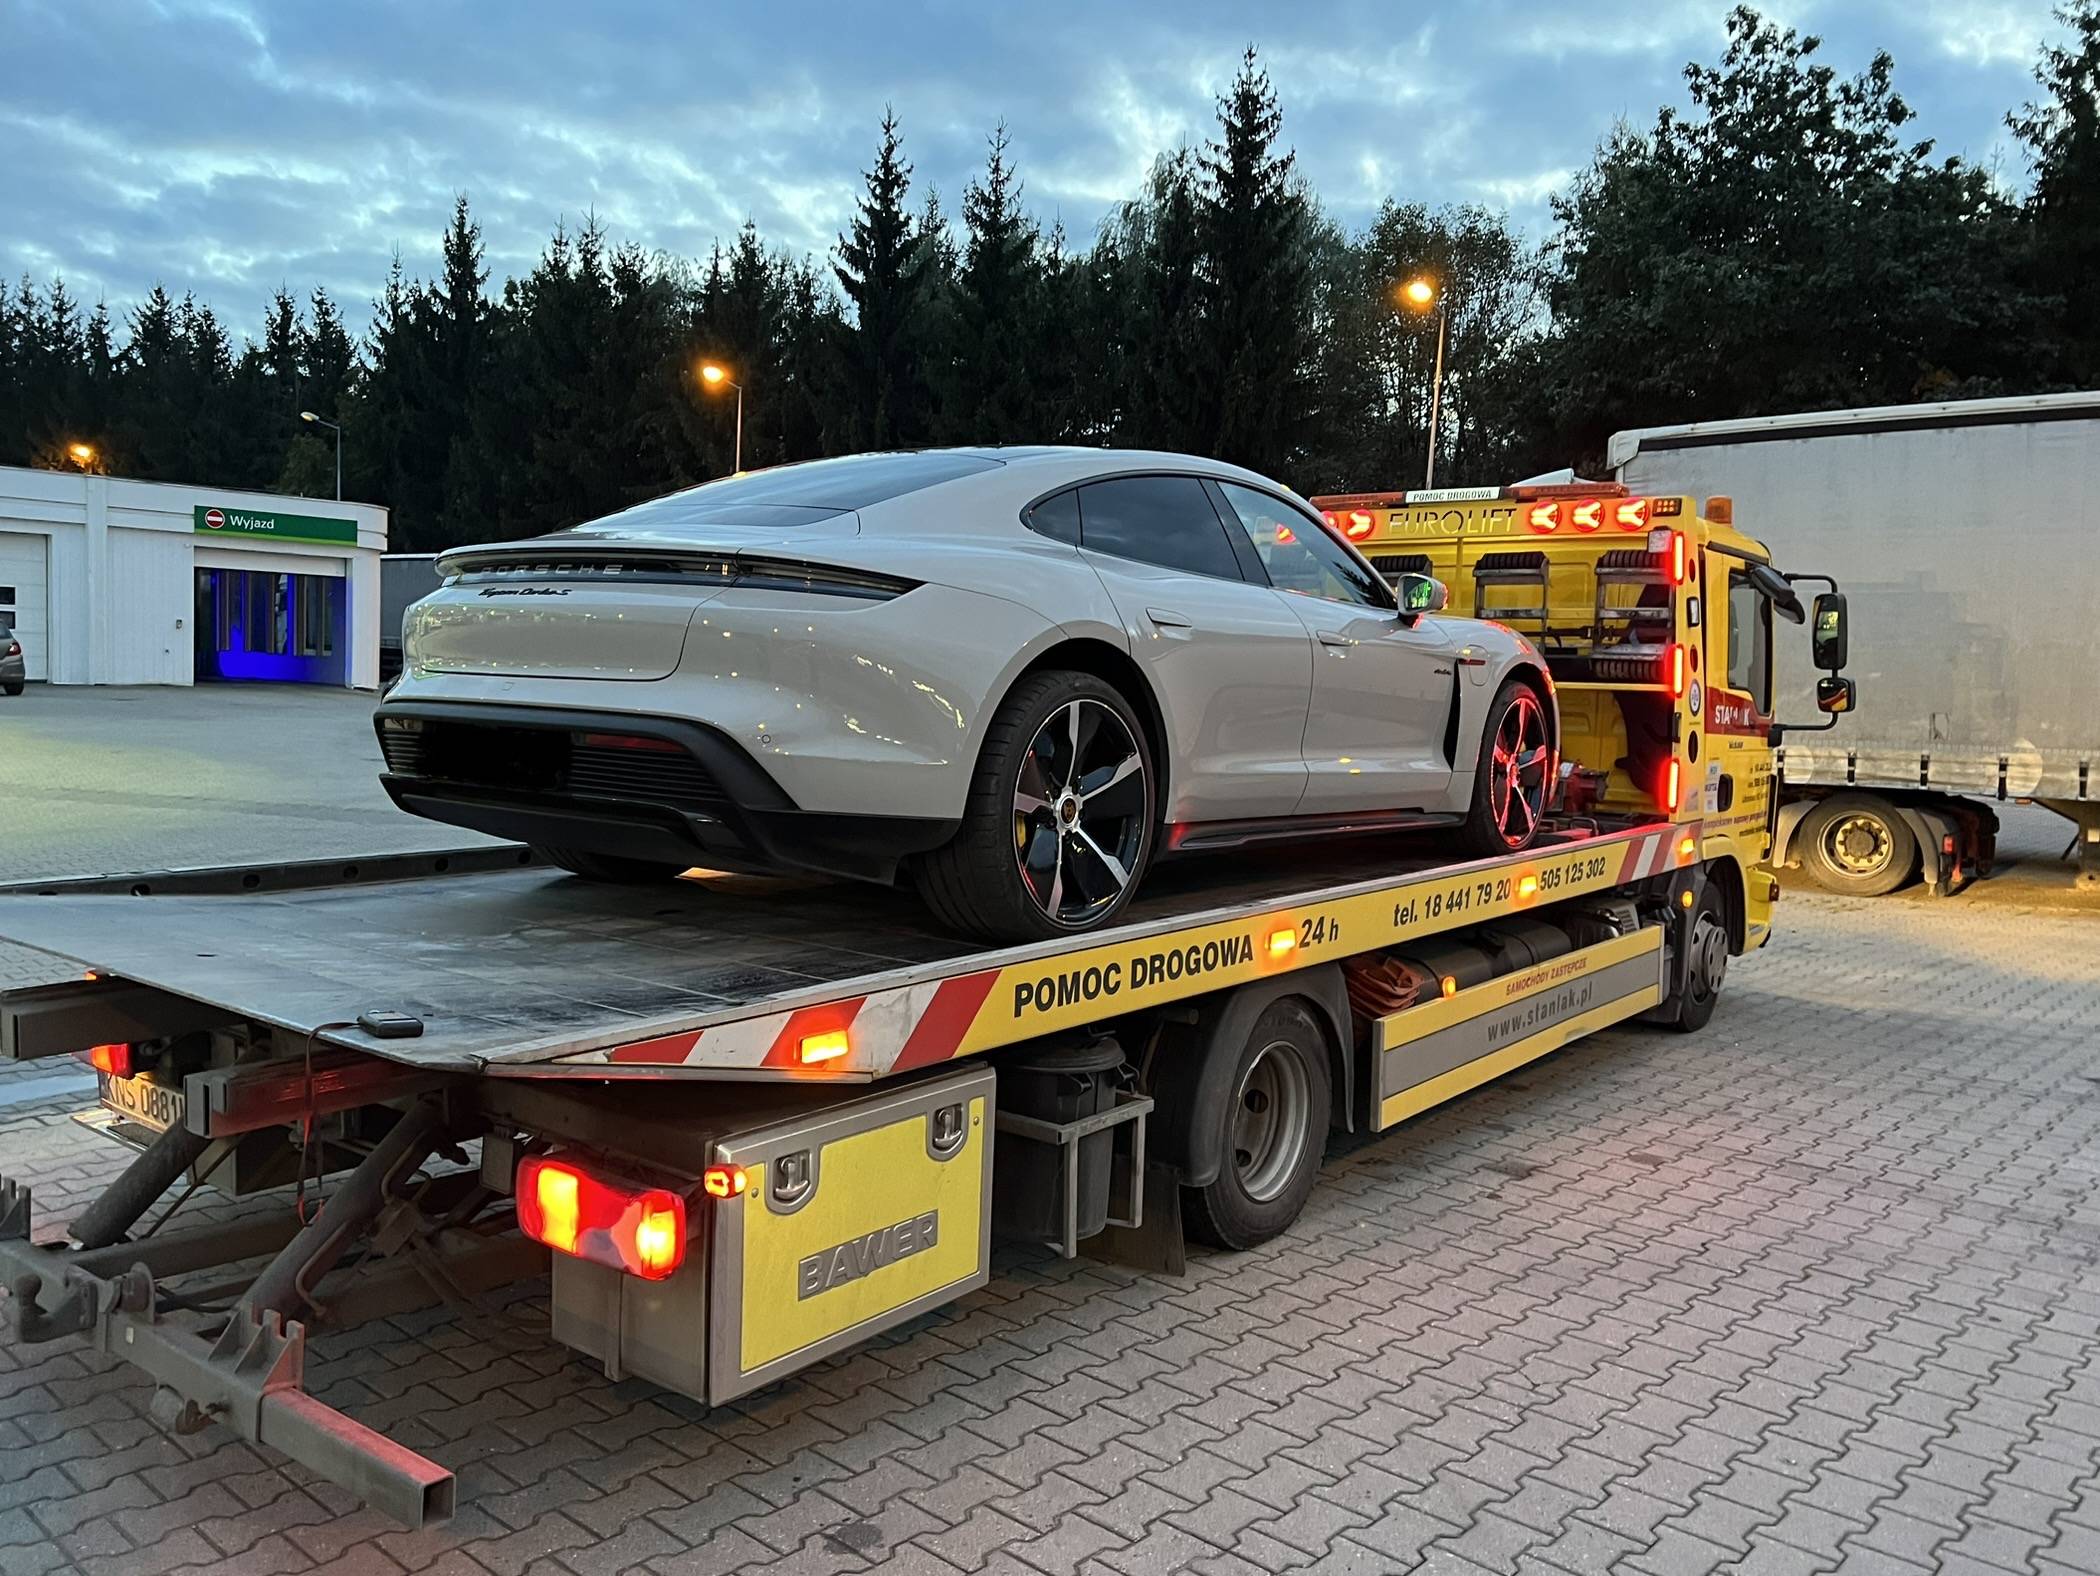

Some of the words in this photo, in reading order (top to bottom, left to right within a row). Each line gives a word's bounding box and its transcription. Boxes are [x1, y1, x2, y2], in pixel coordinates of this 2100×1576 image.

[1413, 490, 1445, 502] POMOC
[1447, 489, 1492, 500] DROGOWA
[230, 515, 275, 530] Wyjazd
[1389, 508, 1517, 535] EUROLIFT
[480, 564, 624, 575] PORSCHE
[1394, 899, 1418, 927] tel.
[1424, 894, 1442, 919] 18
[1446, 886, 1471, 914] 441
[1476, 881, 1492, 907] 79
[1495, 878, 1511, 902] 20
[1540, 867, 1561, 891] 505
[1564, 862, 1584, 885] 125
[1586, 857, 1606, 879] 302
[1013, 962, 1121, 1018] POMOC
[1130, 934, 1254, 990] DROGOWA
[1298, 916, 1325, 949] 24
[1329, 918, 1339, 943] h
[1487, 981, 1593, 1042] www.stanlak.pl
[798, 1210, 938, 1301] BAWER
